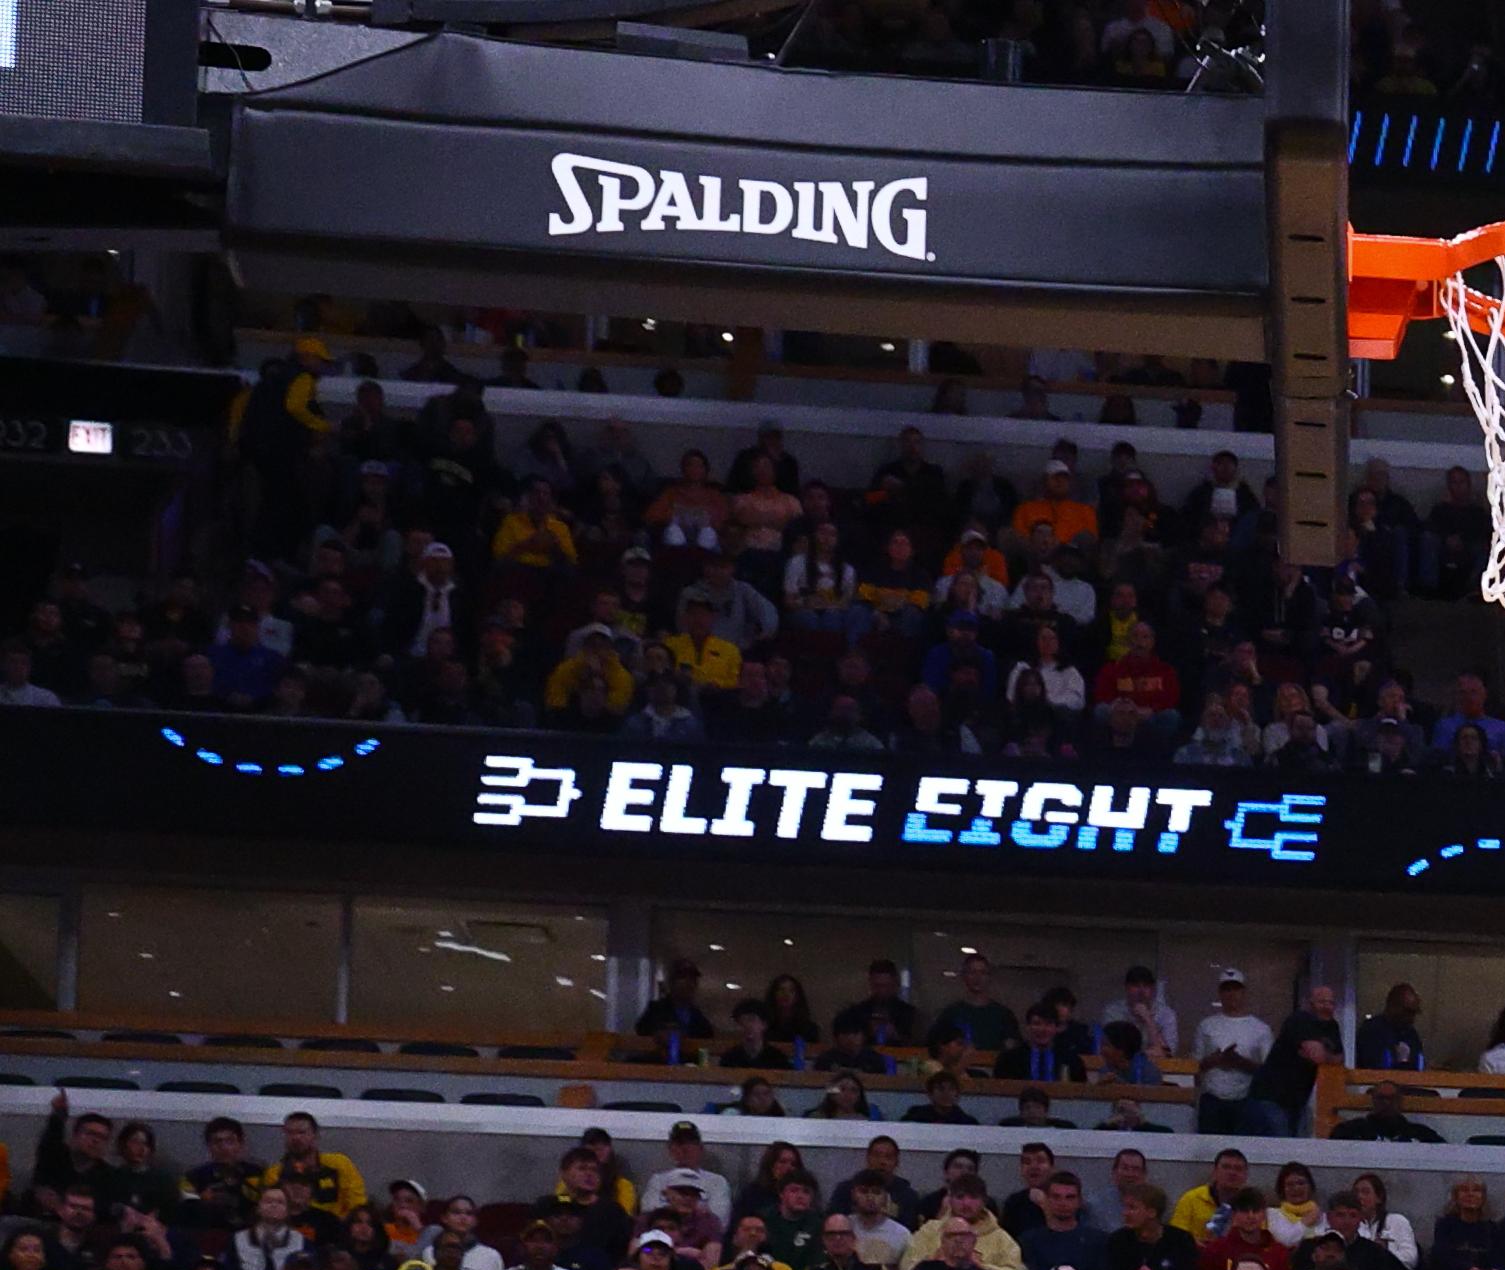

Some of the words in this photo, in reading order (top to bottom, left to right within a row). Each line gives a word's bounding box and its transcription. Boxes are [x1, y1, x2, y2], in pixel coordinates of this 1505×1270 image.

[549, 153, 930, 261] SPALDING
[600, 762, 884, 842] ELITE
[901, 777, 1213, 853] EIGHT
